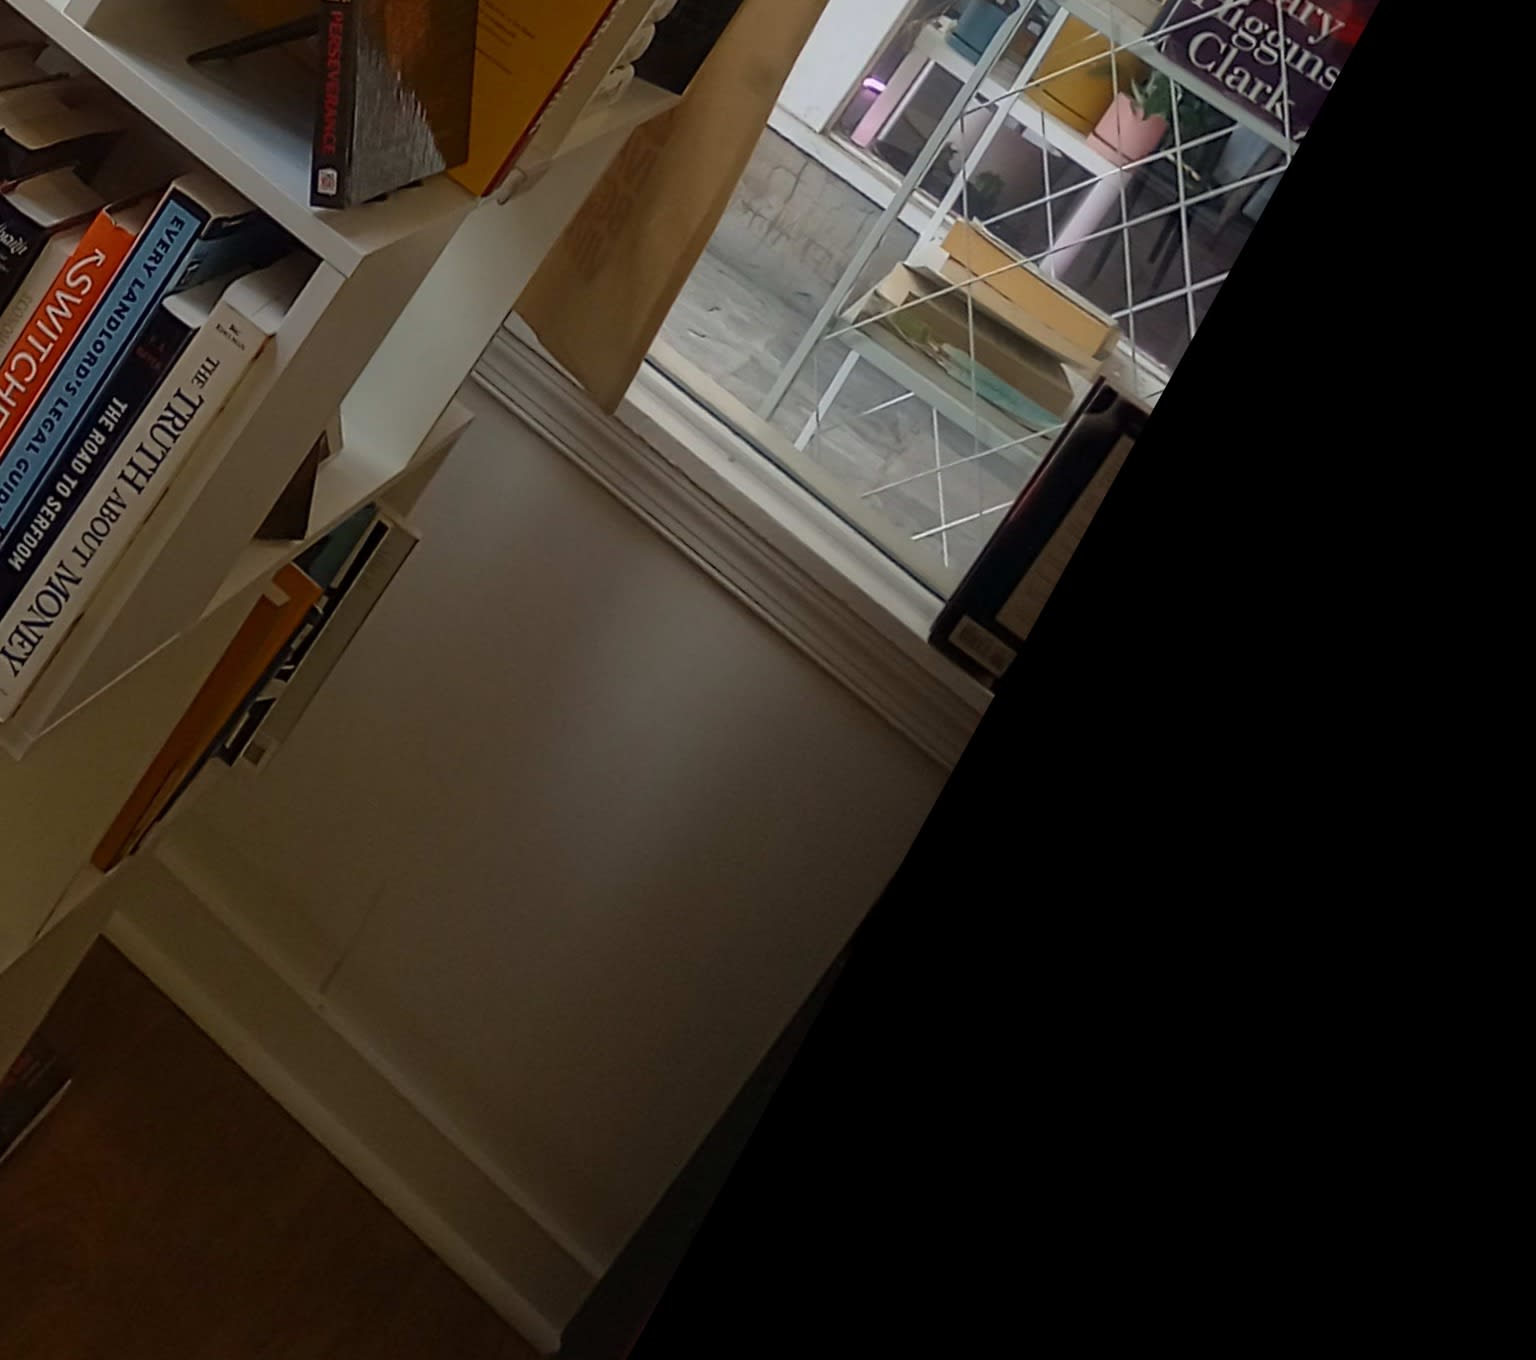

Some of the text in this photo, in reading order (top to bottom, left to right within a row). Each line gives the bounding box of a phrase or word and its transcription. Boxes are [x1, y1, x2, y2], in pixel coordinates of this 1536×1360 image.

[320, 12, 344, 152] PERSEVERANCE
[1183, 26, 1299, 123] Clark
[138, 214, 185, 278] EVERY
[62, 275, 146, 396] LANDLORD'S
[190, 355, 220, 389] THE
[23, 395, 69, 456] LEGAL
[116, 385, 203, 497] TRUTH
[5, 396, 127, 571] THE ROAD TO SERFDOM
[67, 487, 130, 567] ABOUT
